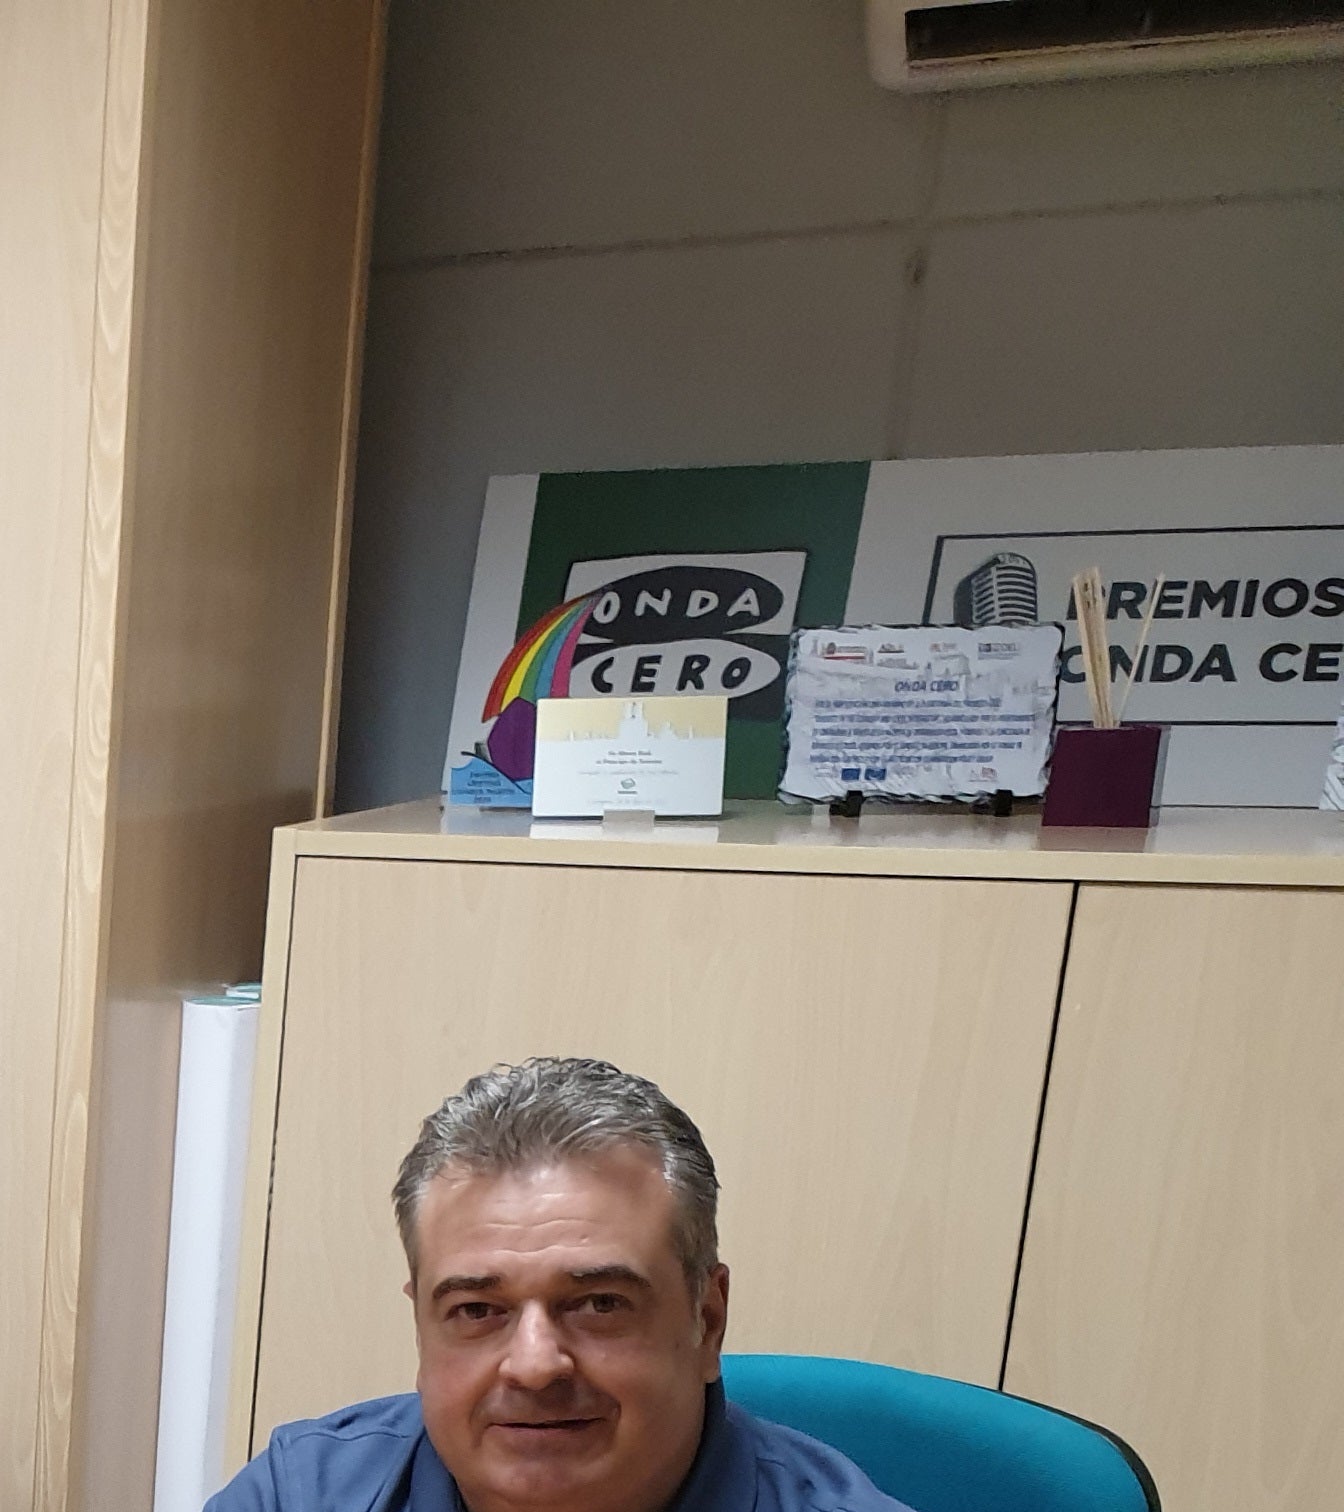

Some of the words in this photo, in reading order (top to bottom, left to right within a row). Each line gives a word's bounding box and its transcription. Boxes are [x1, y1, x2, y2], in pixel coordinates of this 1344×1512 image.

[592, 587, 761, 625] ONDA
[590, 653, 753, 694] CERO
[894, 681, 927, 692] ONDA
